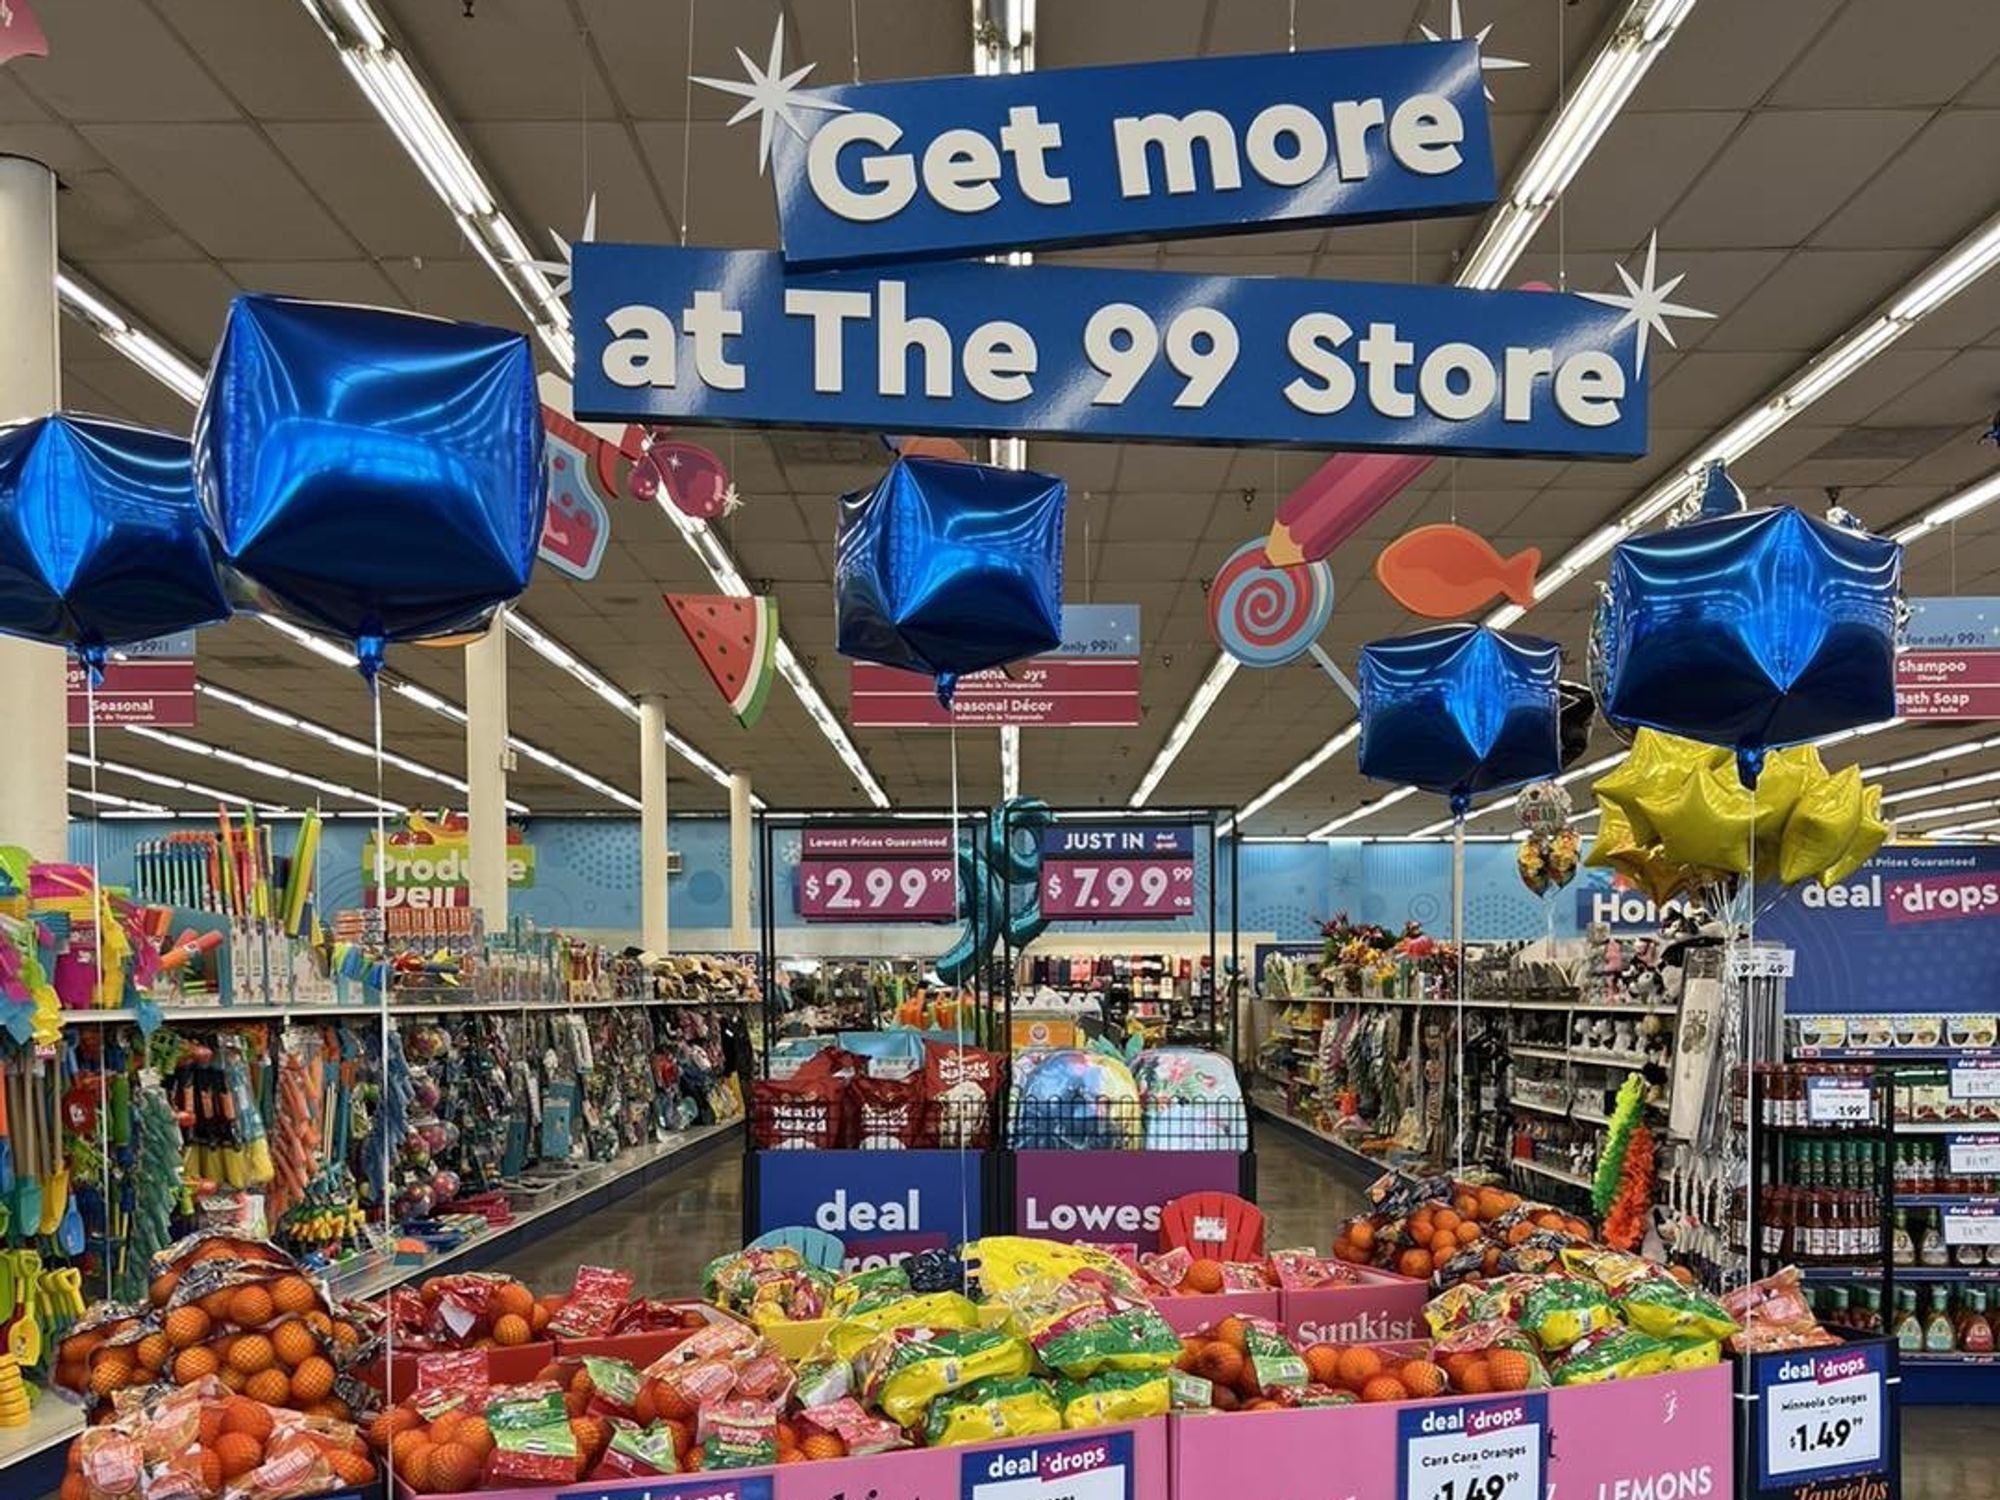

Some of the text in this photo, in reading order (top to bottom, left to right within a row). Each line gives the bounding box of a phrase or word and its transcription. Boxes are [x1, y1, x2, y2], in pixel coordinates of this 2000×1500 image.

[808, 91, 1463, 221] Get more
[601, 280, 1624, 426] at The 99 Store
[1898, 660, 1967, 674] Shampoo
[955, 698, 1053, 712] easonal Décor
[1896, 691, 1969, 706] Bath Soap
[810, 836, 948, 848] Lowest Prices Guaranteed
[1064, 832, 1116, 850] JUST
[1122, 832, 1144, 850] IN
[1911, 856, 1976, 868] Guaranteed
[1802, 875, 1999, 913] deal drops
[816, 1189, 920, 1232] deal
[1026, 1197, 1167, 1232] Lowes
[1298, 1309, 1417, 1343] Sunkist
[1778, 1356, 1866, 1381] deal drops
[1781, 1393, 1868, 1411] Minneola Oranges
[1421, 1405, 1524, 1432] deal drops
[988, 1445, 1106, 1478] deal drops
[1421, 1445, 1527, 1468] Cara Cara Oranges
